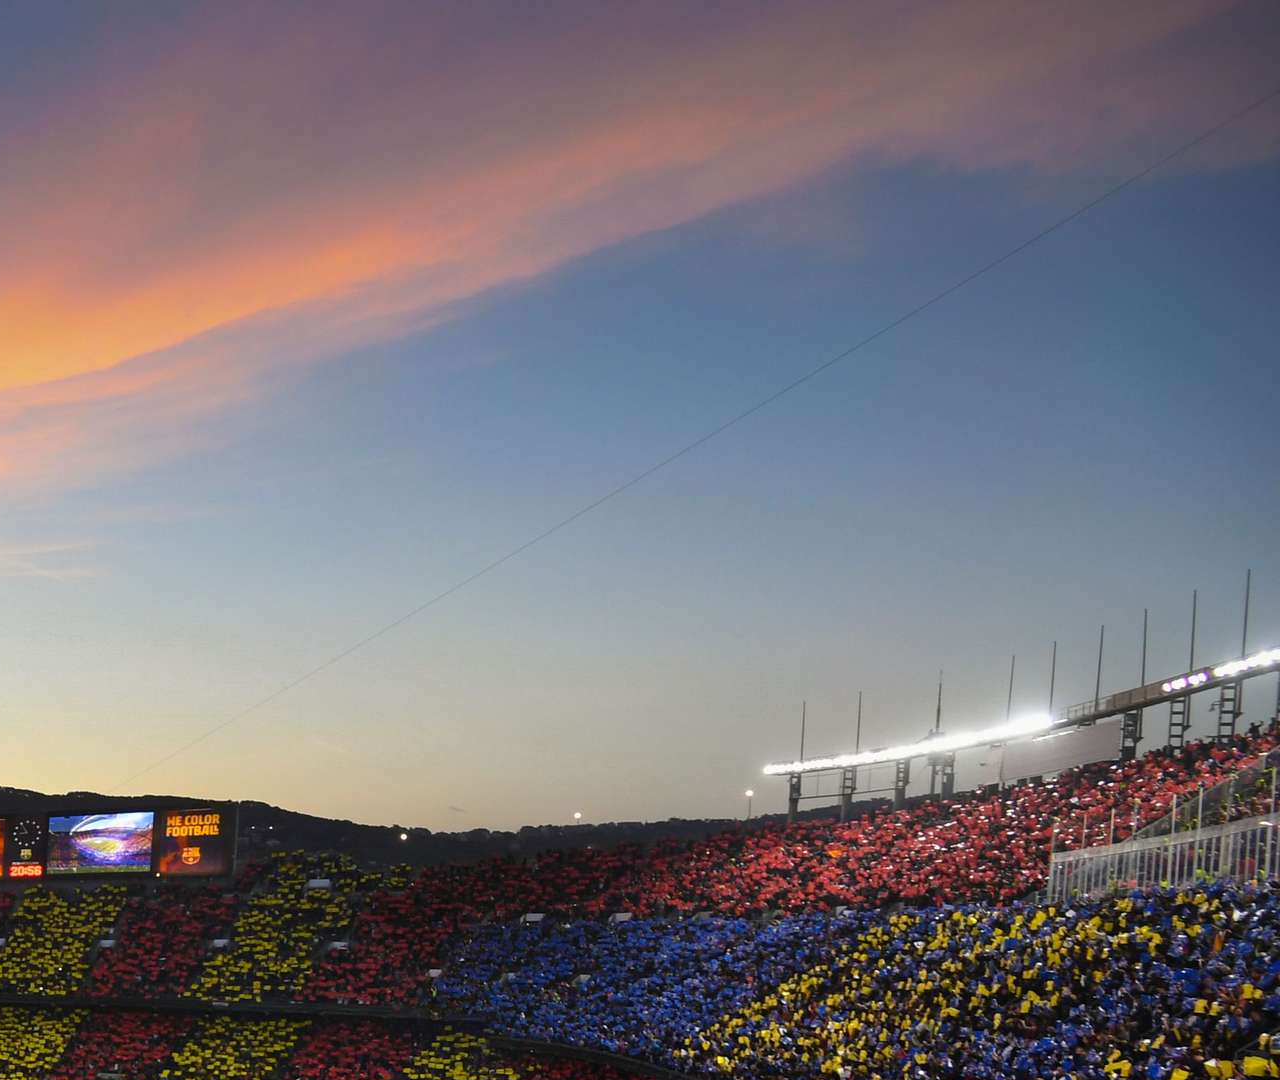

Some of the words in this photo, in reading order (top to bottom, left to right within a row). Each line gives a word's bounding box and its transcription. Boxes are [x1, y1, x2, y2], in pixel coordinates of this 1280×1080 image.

[184, 813, 220, 825] COLOR
[166, 824, 220, 837] FOOTBALL
[9, 865, 42, 877] 20:56
